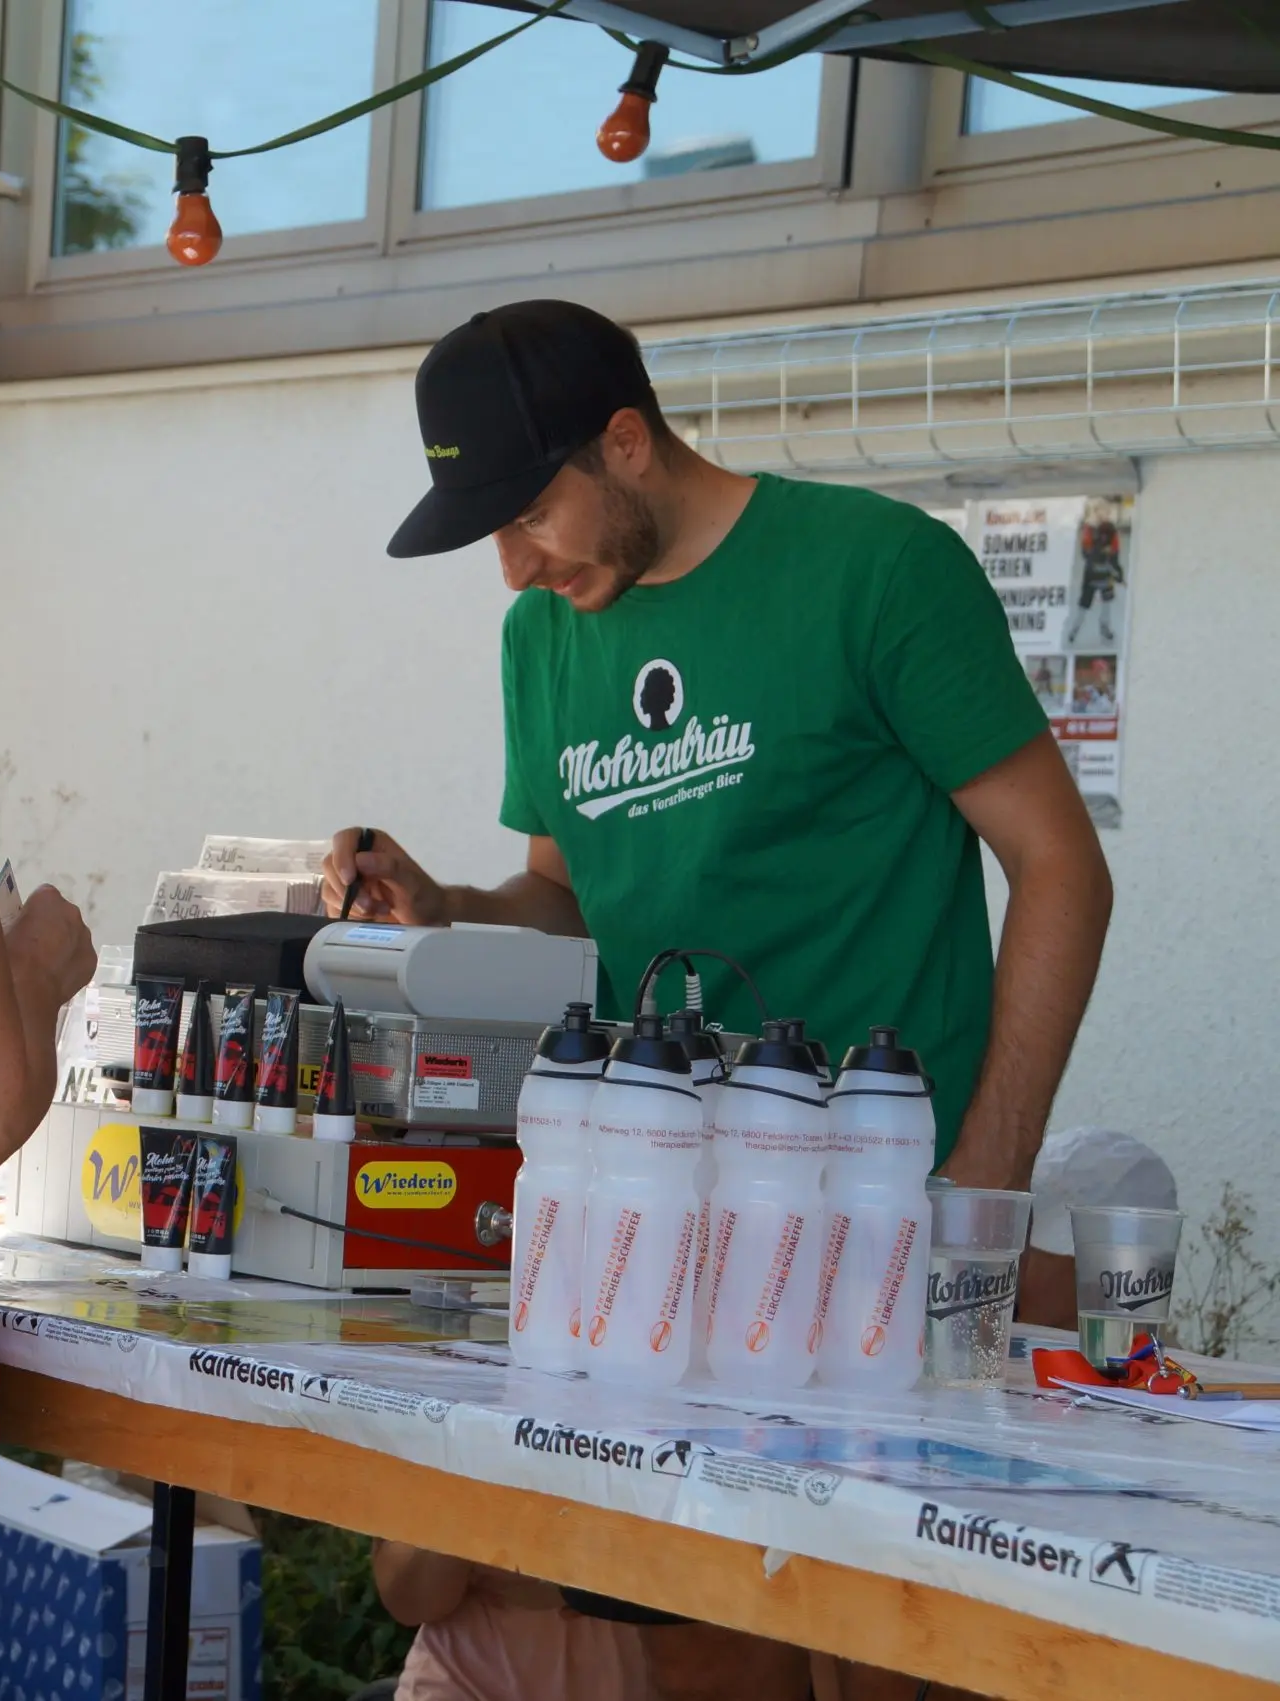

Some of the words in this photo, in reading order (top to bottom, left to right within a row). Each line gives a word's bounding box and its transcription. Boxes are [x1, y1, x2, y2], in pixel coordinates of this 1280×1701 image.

[983, 532, 1048, 555] SOMMER
[558, 714, 755, 801] Mohrenbräu
[627, 803, 649, 818] das
[652, 780, 714, 812] Vorarlberger
[716, 772, 744, 790] Bier
[360, 1172, 453, 1194] Wiederin
[524, 1199, 560, 1302] LERCHER&SCHAEFER
[765, 1215, 804, 1322] LERCHER&SCHAEFER
[880, 1220, 918, 1326] LERCHER&SCHAEFER
[1100, 1265, 1173, 1298] Mohre
[189, 1349, 295, 1394] Raiffeisen
[514, 1416, 645, 1471] Raiffeisen
[915, 1502, 1082, 1579] Raiffeisen
